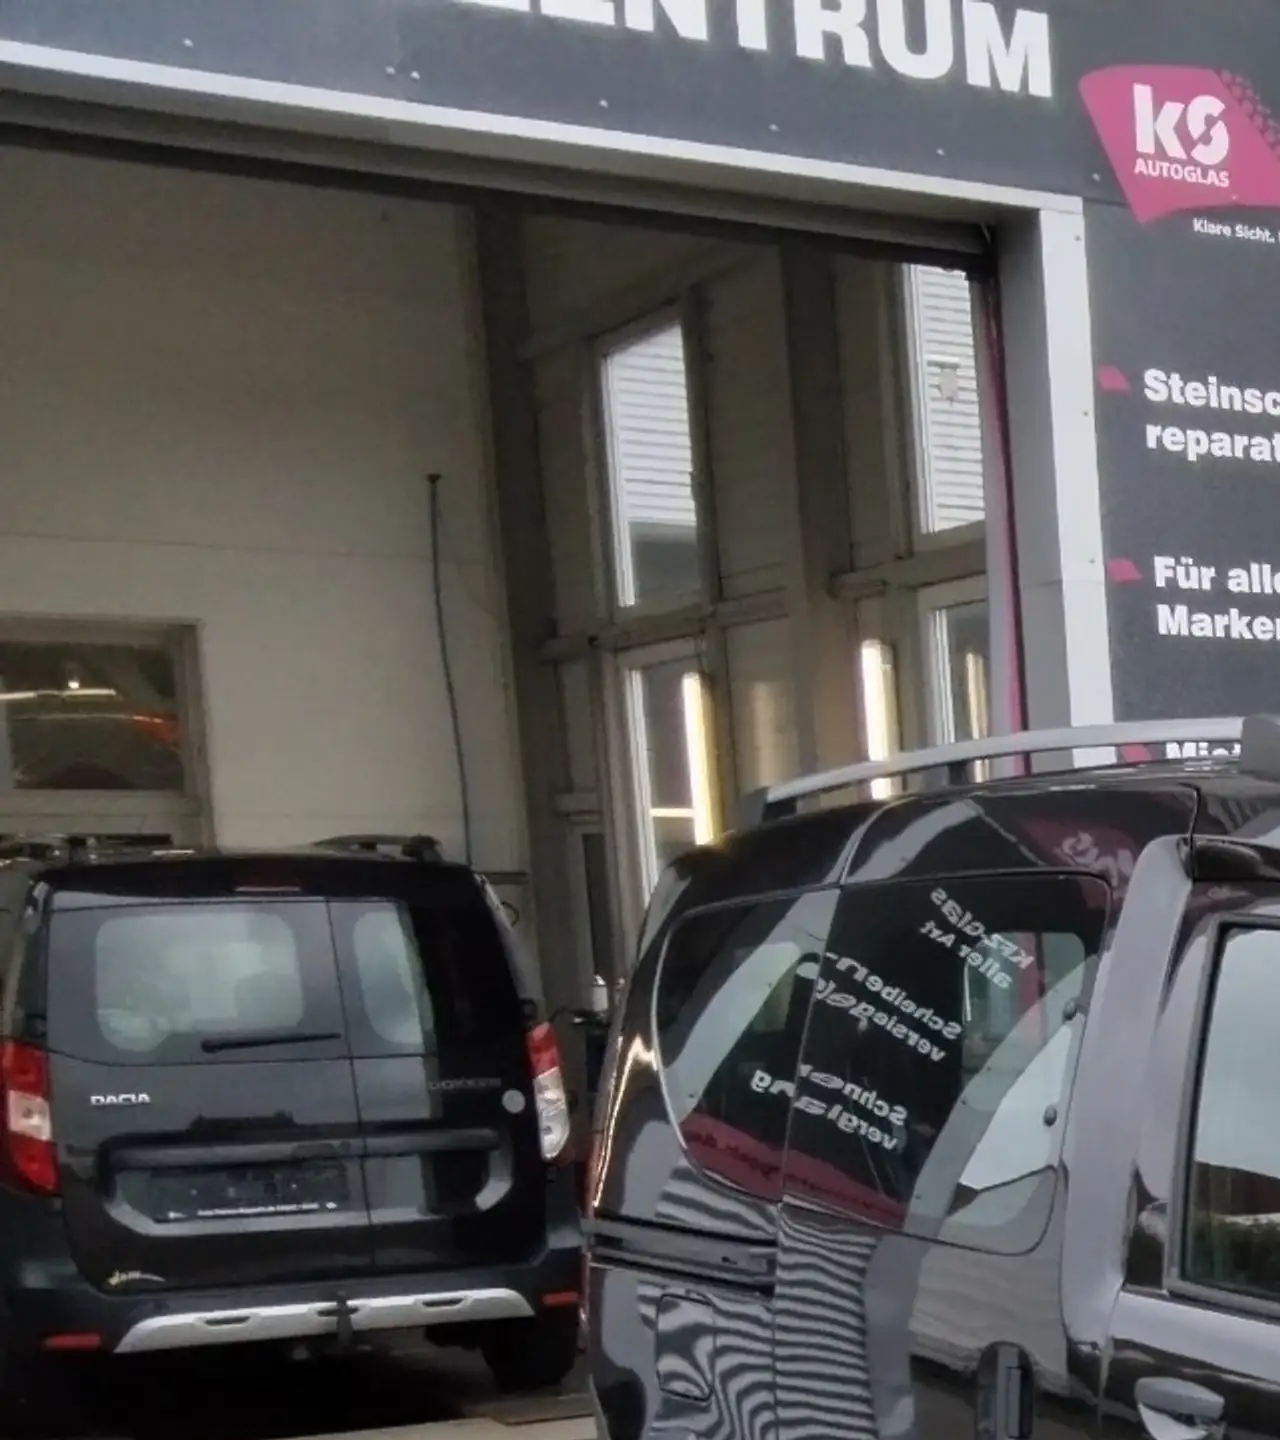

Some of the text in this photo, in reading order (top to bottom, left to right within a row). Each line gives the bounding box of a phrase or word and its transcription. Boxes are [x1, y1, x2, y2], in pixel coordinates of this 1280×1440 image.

[1133, 157, 1230, 188] AUTOGLAS
[1193, 217, 1232, 237] Klare
[1235, 223, 1275, 243] Sicht.
[1153, 555, 1216, 591] Für
[89, 1093, 151, 1106] DACIA
